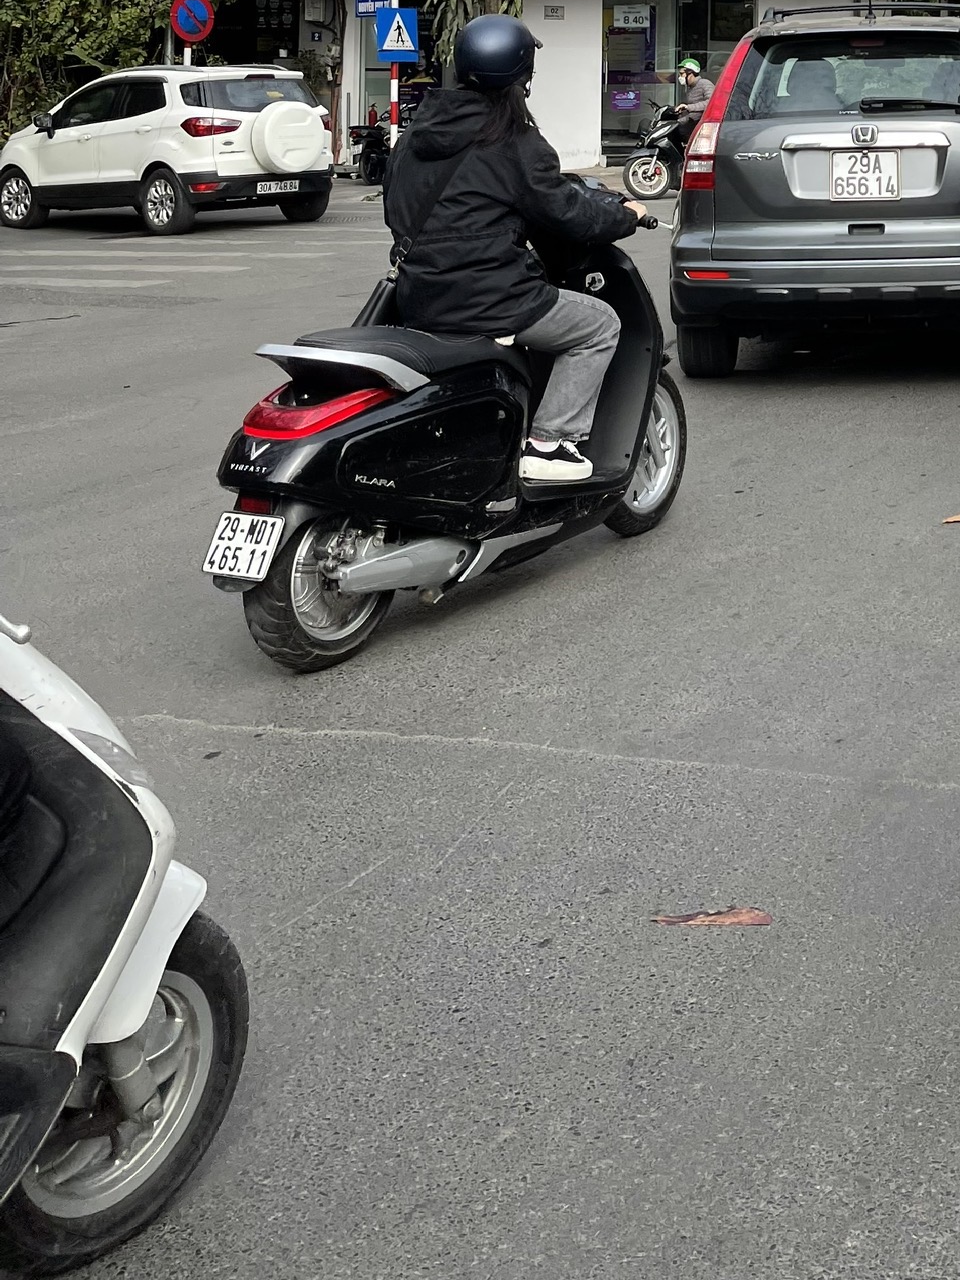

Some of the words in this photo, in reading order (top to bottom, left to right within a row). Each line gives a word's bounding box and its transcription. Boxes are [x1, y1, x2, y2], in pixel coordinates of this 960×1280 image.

[847, 154, 883, 175] 29A
[833, 176, 897, 197] 656.14
[354, 473, 397, 489] KLARA
[207, 544, 267, 576] 465.11
